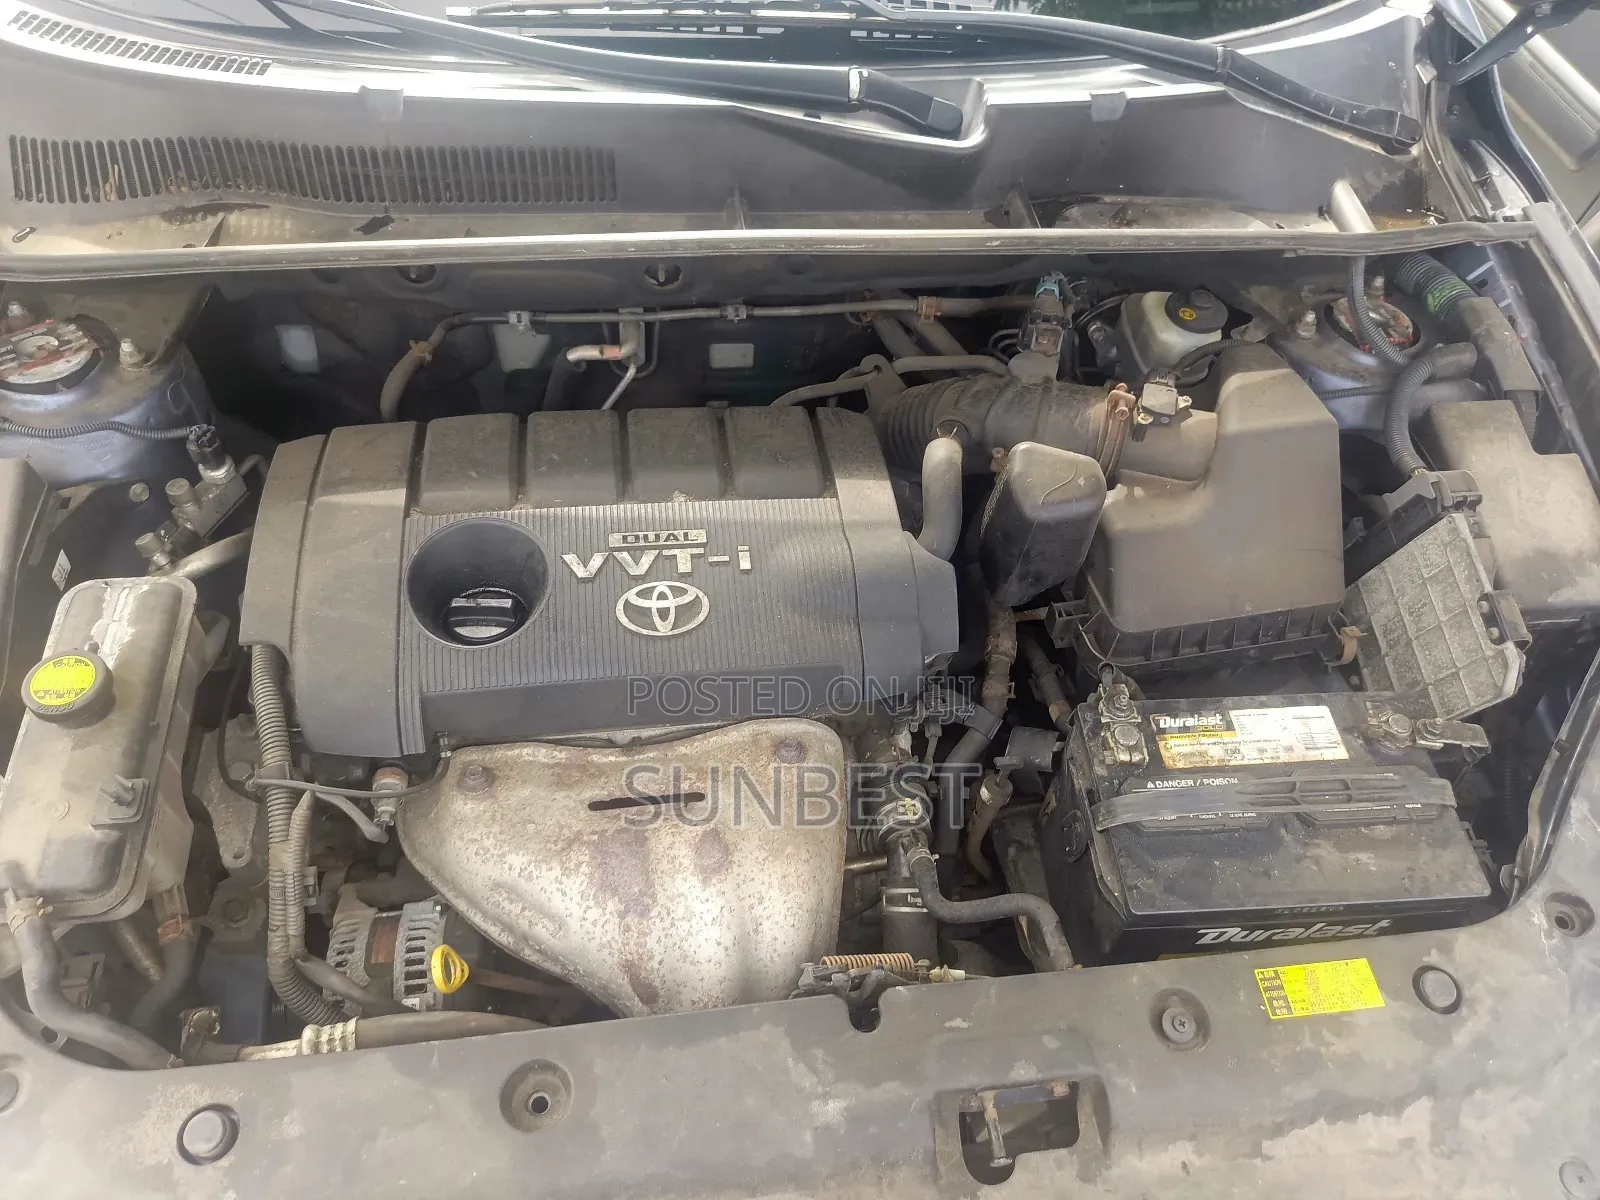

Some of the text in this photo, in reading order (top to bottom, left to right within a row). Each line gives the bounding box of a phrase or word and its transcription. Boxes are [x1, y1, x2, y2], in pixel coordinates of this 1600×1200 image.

[622, 532, 699, 544] DUAL
[561, 545, 752, 578] VVT-i
[1154, 713, 1223, 728] Duralast
[1155, 778, 1195, 788] DANGER
[1202, 777, 1239, 786] POISON
[1194, 918, 1394, 945] Duralast
